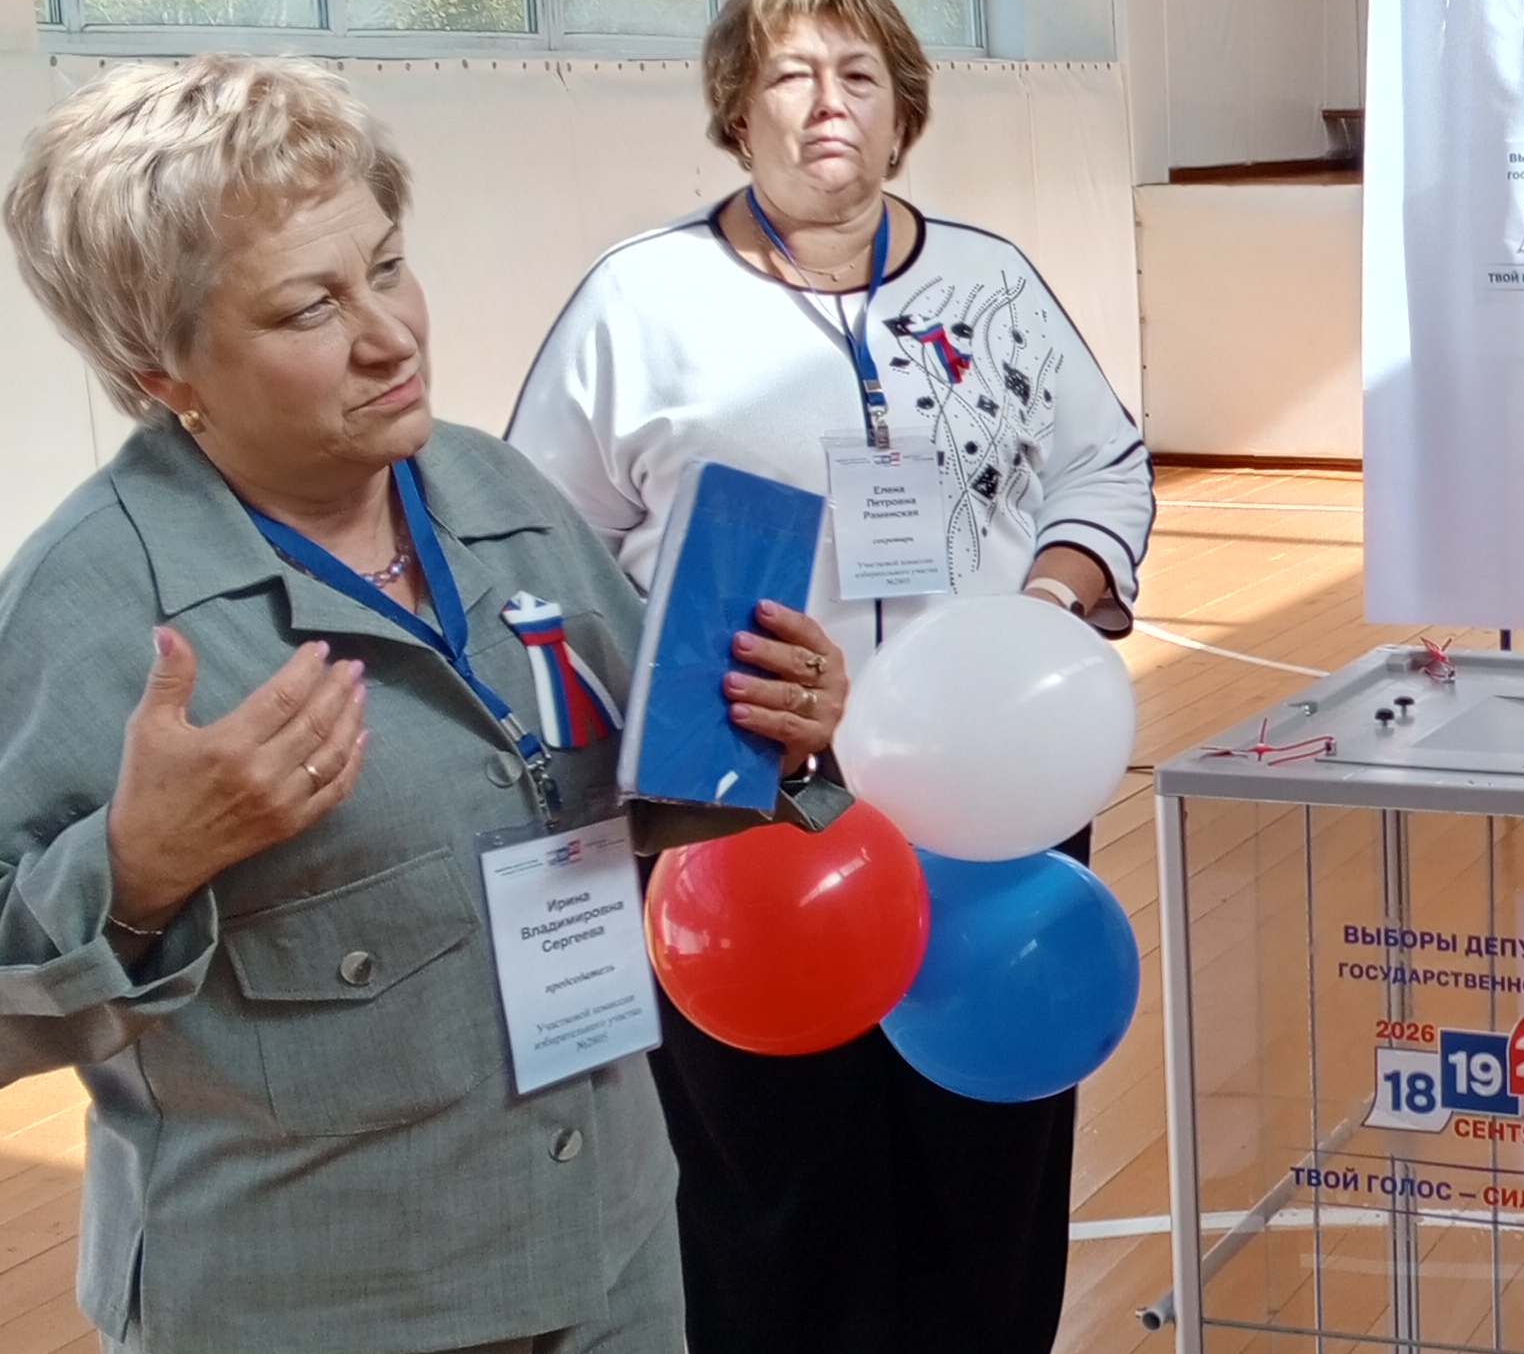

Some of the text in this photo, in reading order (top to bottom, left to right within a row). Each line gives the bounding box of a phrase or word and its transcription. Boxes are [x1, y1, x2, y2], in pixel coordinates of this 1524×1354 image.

[1488, 270, 1519, 284] ТВОЙ
[546, 891, 591, 914] Ирина
[521, 899, 625, 941] Владимировна
[541, 924, 606, 953] Сергеева
[1343, 925, 1457, 953] ВЫБОРЫ
[1375, 1020, 1435, 1043] 2026
[1383, 1070, 1436, 1114] 18
[1448, 1051, 1503, 1096] 19
[1290, 1166, 1359, 1192] ТВОЙ
[1366, 1174, 1452, 1201] ГОЛОС
